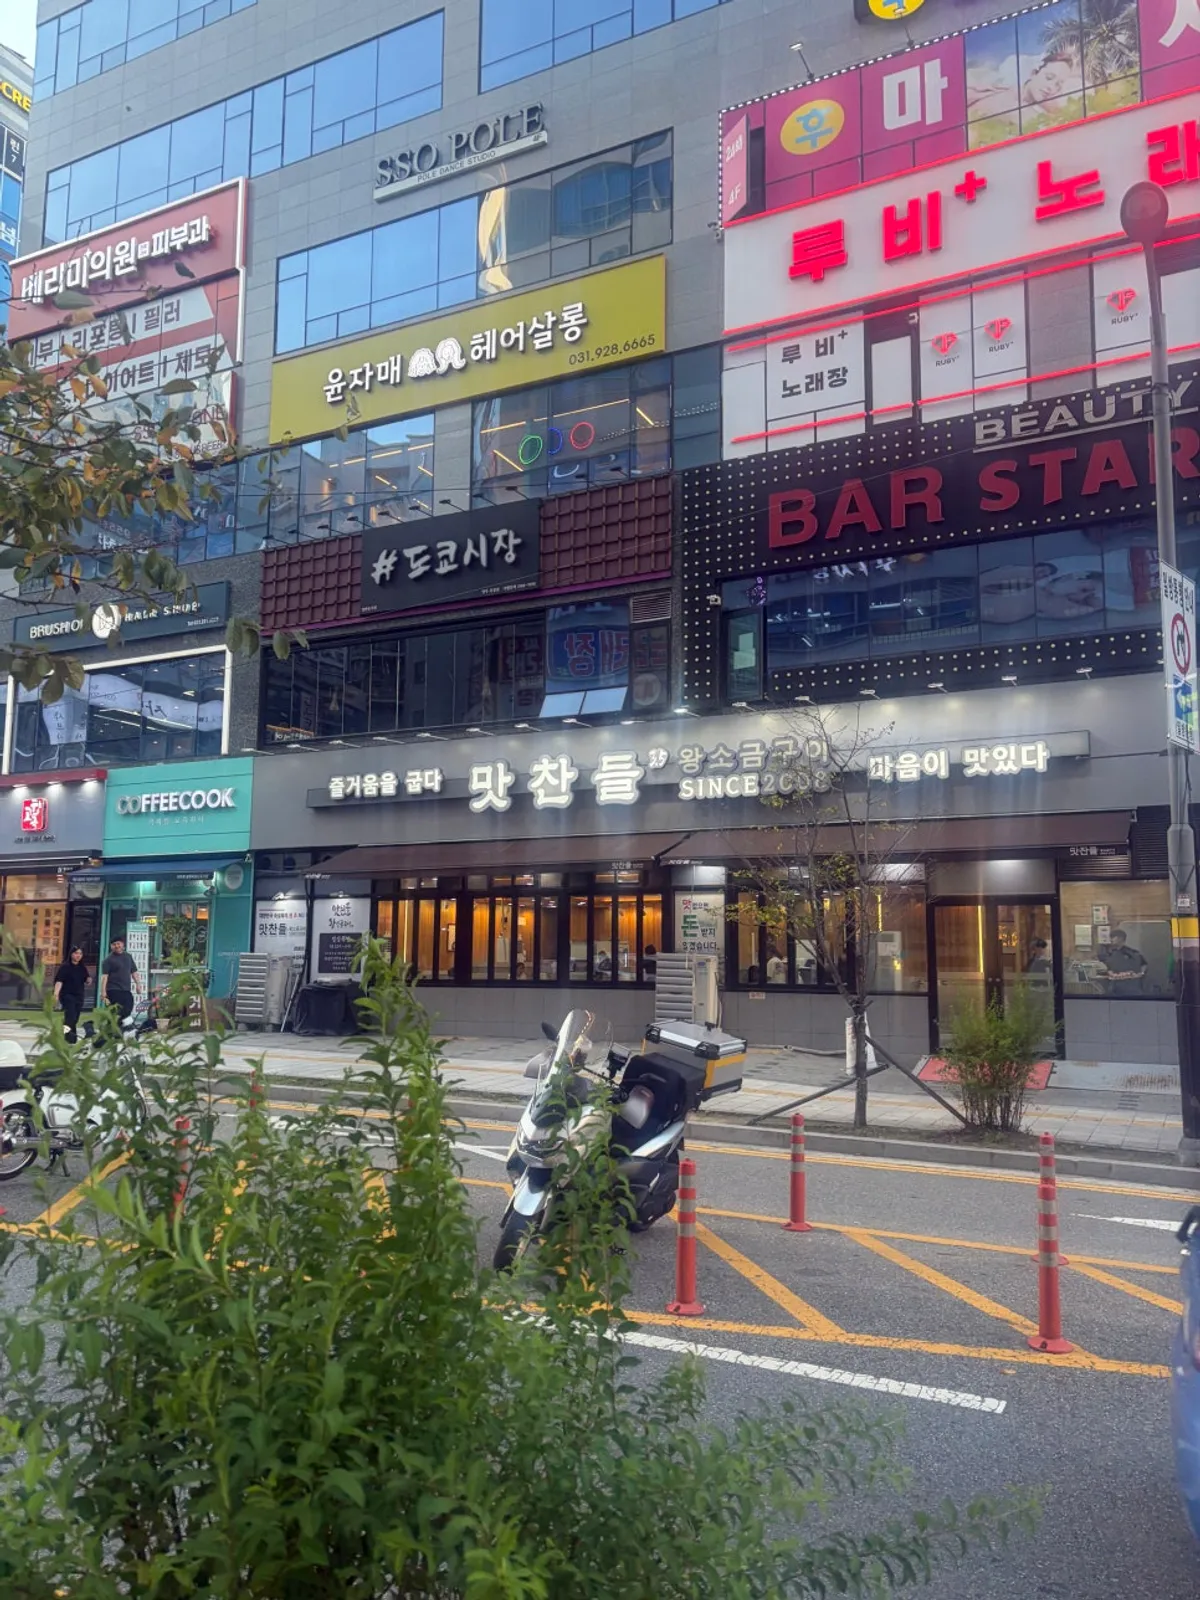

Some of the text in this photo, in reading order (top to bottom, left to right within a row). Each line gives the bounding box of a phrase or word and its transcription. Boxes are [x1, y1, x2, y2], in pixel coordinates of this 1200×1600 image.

[795, 58, 949, 149] 후 마
[375, 101, 546, 189] SSO POLE
[417, 150, 496, 183] POLE DANCE STUDIO
[151, 215, 211, 257] 피부과
[144, 298, 181, 331] 필러
[322, 301, 589, 404] 윤자매 헤어살롱
[568, 333, 657, 367] 031.928.6665
[781, 366, 849, 399] 노래장
[974, 379, 1194, 446] BEAUTY
[768, 426, 1200, 549] BAR STAR
[329, 773, 398, 800] 즐거움을
[404, 767, 444, 795] 굽다
[470, 753, 643, 812] 맛찬들
[680, 735, 830, 775] 왕소금구이
[868, 742, 1049, 782] 마음이 맛있다
[116, 787, 236, 815] COFFEECOOK
[678, 775, 760, 799] SINCE
[258, 923, 287, 936] 맛찬들
[681, 914, 699, 938] 돈
